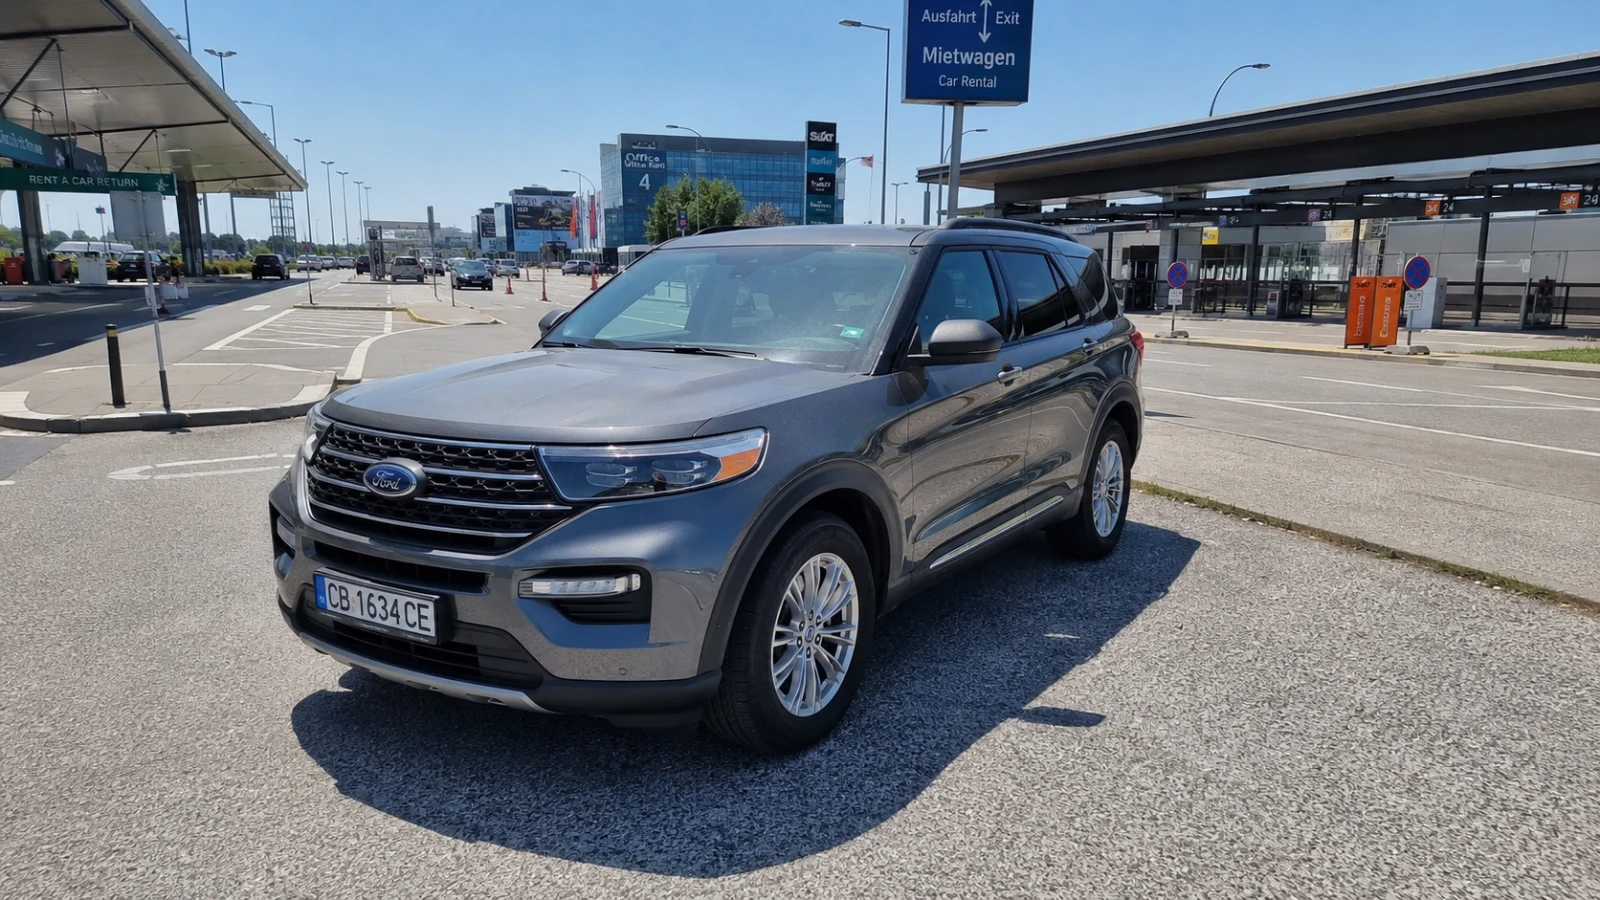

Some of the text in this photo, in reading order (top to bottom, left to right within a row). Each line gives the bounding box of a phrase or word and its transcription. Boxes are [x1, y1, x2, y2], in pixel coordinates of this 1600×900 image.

[921, 9, 1020, 25] Ausfahrt Exit
[922, 46, 1016, 70] Mietwagen
[938, 74, 997, 88] Car Rental
[29, 175, 139, 187] RENT A CAR RETURN
[638, 173, 651, 191] 4
[372, 470, 402, 490] Ford
[327, 582, 431, 632] CB 1634 CE
